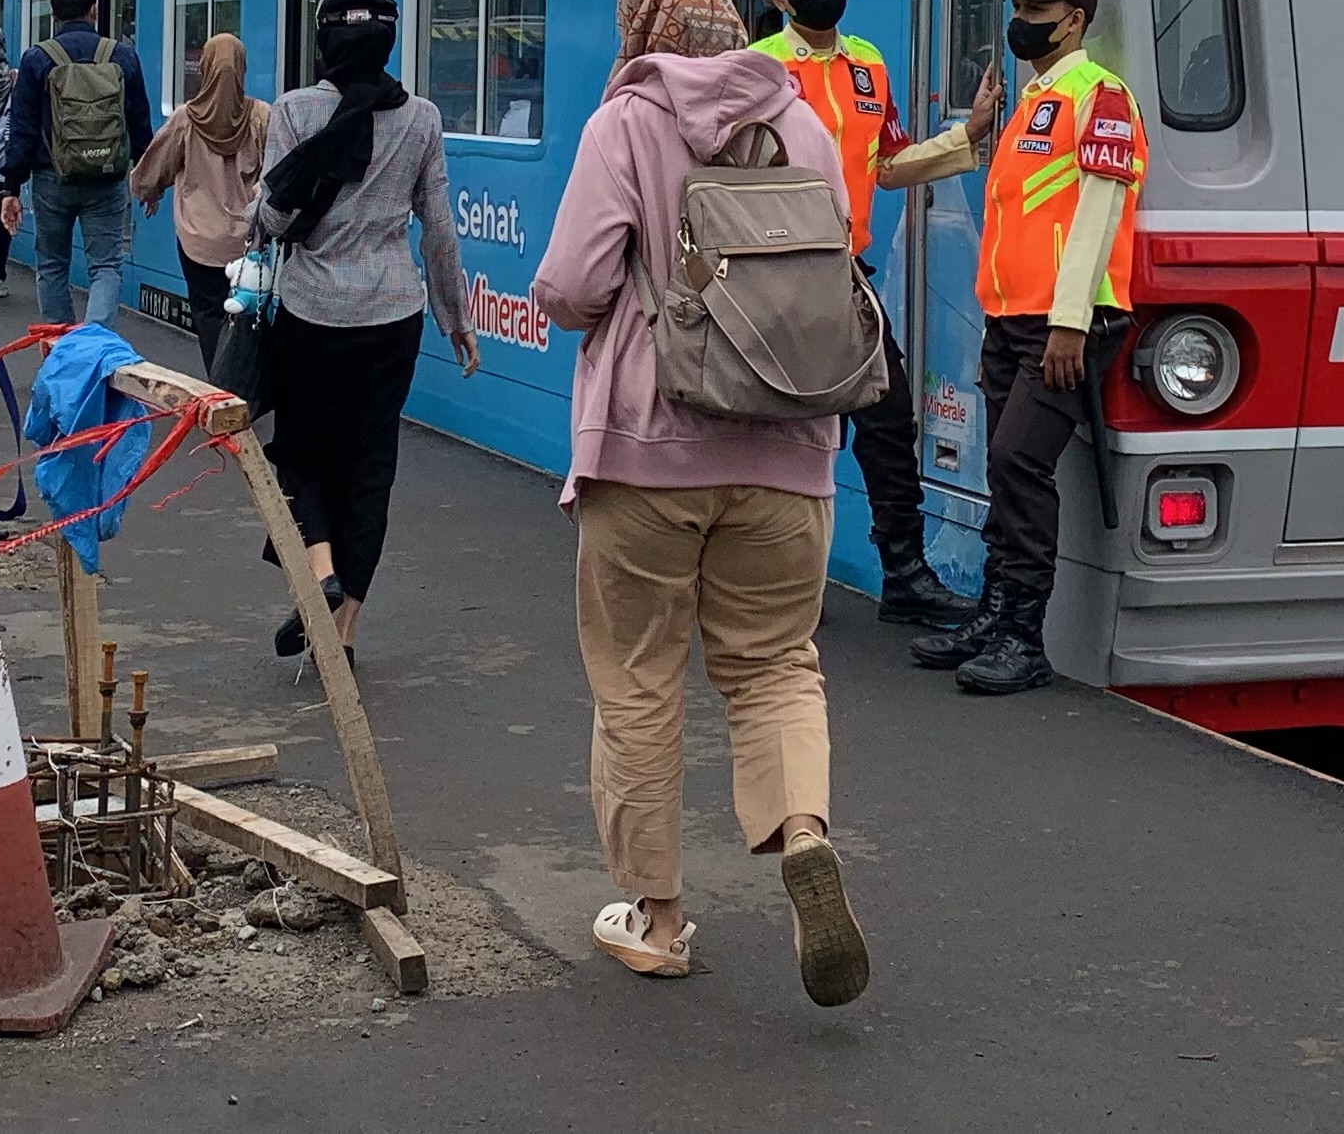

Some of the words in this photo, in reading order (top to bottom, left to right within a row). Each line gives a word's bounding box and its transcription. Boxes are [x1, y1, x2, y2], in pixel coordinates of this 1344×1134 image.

[1018, 141, 1049, 151] SATPAM
[457, 190, 525, 255] Sehat,
[942, 376, 955, 401] Le
[921, 392, 967, 423] Minerale
